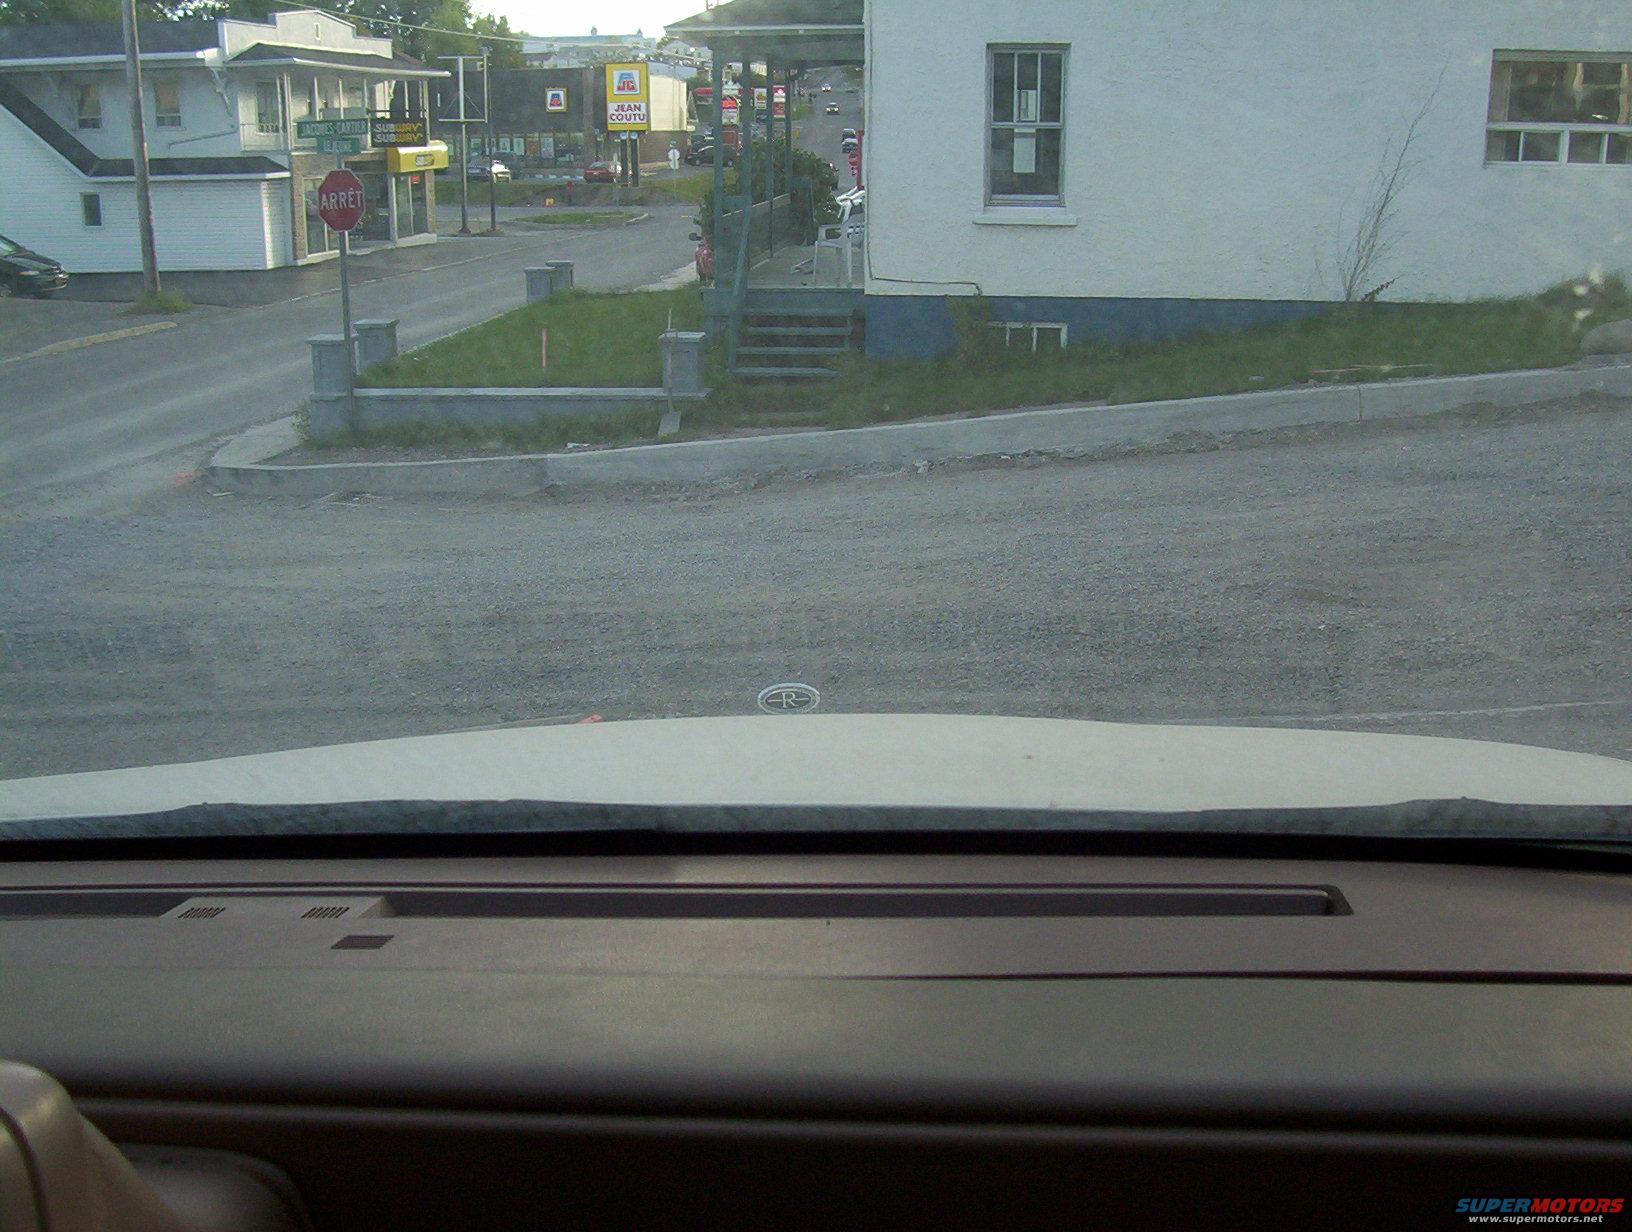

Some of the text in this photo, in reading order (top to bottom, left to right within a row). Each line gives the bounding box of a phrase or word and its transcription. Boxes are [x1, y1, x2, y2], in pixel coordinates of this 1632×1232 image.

[615, 104, 641, 112] JEAN
[609, 113, 646, 122] COUTU
[373, 122, 423, 133] SUBWAY
[373, 133, 424, 143] SUBWAY
[320, 187, 363, 211] ARRÊT
